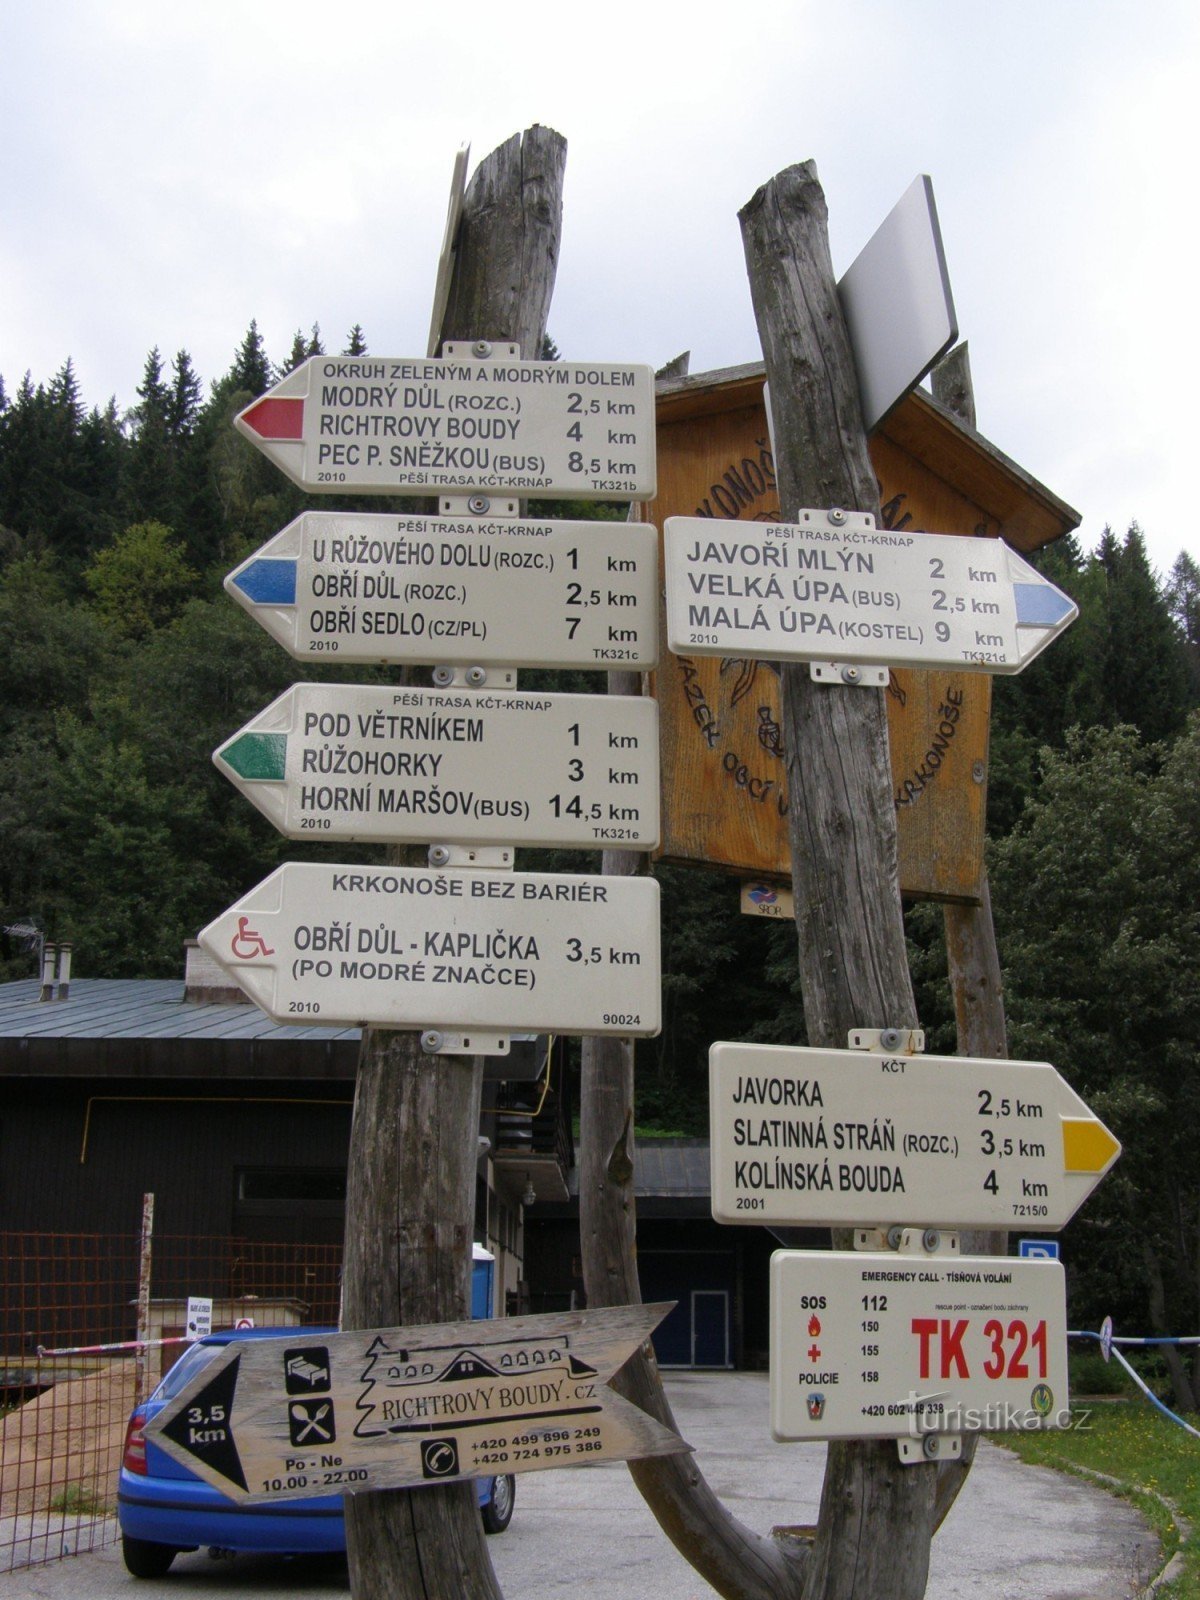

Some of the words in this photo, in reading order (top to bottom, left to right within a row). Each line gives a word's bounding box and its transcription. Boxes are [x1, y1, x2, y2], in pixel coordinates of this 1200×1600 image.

[323, 363, 385, 379] OKRUH
[390, 363, 472, 382] ZELENÝM
[475, 369, 489, 382] A
[492, 366, 570, 385] MODRÝM
[575, 370, 635, 386] DOLEM
[321, 383, 397, 408] MODRÝ
[566, 393, 601, 416] 2,5
[607, 397, 636, 415] km
[319, 414, 441, 438] RICHTROVY
[446, 416, 521, 440] BOUDY
[566, 422, 583, 442] 4
[607, 428, 637, 445] km
[318, 444, 359, 466] PEC
[367, 445, 383, 467] P.
[389, 441, 490, 469] SNĚŽKOU
[567, 451, 601, 475] 8,5
[607, 457, 637, 475] km
[318, 472, 346, 482] 2010
[399, 472, 428, 484] PĚŠÍ
[432, 473, 475, 485] TRASA
[478, 474, 553, 488] KČT-KRNAP
[591, 480, 637, 491] TK321b
[397, 520, 427, 533] PĚŠÍ
[430, 522, 474, 535] TRASA
[477, 523, 553, 537] KČT-KRNAP
[766, 526, 795, 539] PĚŠÍ
[798, 530, 840, 542] TRASA
[843, 531, 914, 548] KČT-KRNAP
[313, 540, 325, 562] U
[331, 535, 435, 566] RŮŽOVÉHO
[567, 548, 578, 570] 1
[607, 557, 637, 572] km
[686, 539, 789, 569] JAVOŘÍ
[798, 546, 874, 574] MLÝN
[928, 558, 946, 579] 2
[968, 566, 997, 583] km
[312, 570, 358, 598] OBŘÍ
[565, 583, 601, 607] 2,5
[607, 591, 637, 607] km
[687, 572, 788, 599] VELKÁ
[793, 574, 849, 604] ÚPA
[932, 589, 966, 614] 2,5
[970, 598, 1000, 615] km
[310, 606, 356, 633] OBŘÍ
[565, 618, 581, 640] 7
[608, 625, 638, 642] km
[688, 603, 771, 631] MALÁ
[779, 605, 837, 636] ÚPA
[934, 621, 951, 643] 9
[974, 630, 1004, 647] km
[309, 641, 339, 651] 2010
[689, 633, 718, 645] 2010
[592, 648, 639, 661] TK321c
[961, 650, 1007, 664] TK321d
[392, 694, 423, 708] PĚŠÍ
[427, 696, 472, 709] TRASA
[475, 697, 553, 712] KČT-KRNAP
[305, 712, 351, 737] POD
[358, 709, 484, 742] VĚTRNÍKEM
[568, 723, 580, 747] 1
[608, 732, 638, 749] km
[895, 686, 963, 811] KRKONOŠE
[302, 746, 443, 778] RŮŽOHORKY
[567, 759, 585, 782] 3
[608, 768, 639, 785] km
[301, 782, 372, 812] HORNÍ
[548, 795, 602, 822] 14,5
[609, 803, 640, 821] km
[300, 818, 331, 830] 2010
[592, 828, 639, 839] TK321e
[332, 870, 463, 898] KRKONOŠE
[471, 880, 516, 899] BEZ
[522, 881, 608, 903] BARIÉR
[294, 920, 351, 953] OBŘÍ
[423, 928, 540, 961] KAPLIČKA
[566, 939, 602, 965] 3,5
[609, 948, 641, 966] km
[339, 960, 425, 983] MODRÉ
[432, 963, 537, 991] ZNAČCE)
[288, 1002, 321, 1014] 2010
[602, 1013, 641, 1026] 90024
[881, 1058, 906, 1074] KČT
[732, 1076, 824, 1108] JAVORKA
[977, 1089, 1011, 1119] 2,5
[1016, 1100, 1043, 1118] km
[733, 1115, 828, 1151] SLATINNÁ
[833, 1117, 895, 1152] STRÁŇ
[980, 1129, 1013, 1158] 3,5
[1019, 1139, 1046, 1157] km
[735, 1156, 833, 1191] KOLÍNSKÁ
[839, 1165, 905, 1193] BOUDA
[983, 1170, 1000, 1196] 4
[1022, 1179, 1049, 1197] km
[736, 1198, 765, 1210] 2001
[1012, 1204, 1048, 1217] 7215/0
[861, 1271, 916, 1282] EMERGENCY
[919, 1272, 940, 1282] CALL
[983, 1272, 1012, 1284] VOLÁNÍ
[800, 1296, 827, 1309] SOS
[861, 1295, 888, 1311] 112
[861, 1321, 879, 1332] 150
[861, 1345, 879, 1356] 155
[911, 1318, 970, 1380] TK
[983, 1318, 1048, 1380] 321
[799, 1373, 839, 1385] POLICIE
[861, 1371, 879, 1383] 158
[188, 1405, 225, 1424] 3,5
[382, 1387, 495, 1421] RICHTROVY
[861, 1405, 885, 1417] +420
[887, 1404, 905, 1416] 602
[927, 1403, 944, 1415] 338
[189, 1428, 225, 1443] km
[471, 1438, 507, 1451] +420
[511, 1434, 538, 1446] 499
[543, 1430, 569, 1443] 896
[574, 1427, 601, 1439] 249
[285, 1460, 305, 1471] Po
[321, 1455, 343, 1468] Ne
[472, 1452, 509, 1465] +420
[513, 1449, 540, 1460] 724
[544, 1445, 571, 1457] 975
[576, 1441, 602, 1453] 386
[262, 1476, 308, 1492] 10.00
[323, 1469, 368, 1485] 22.00
